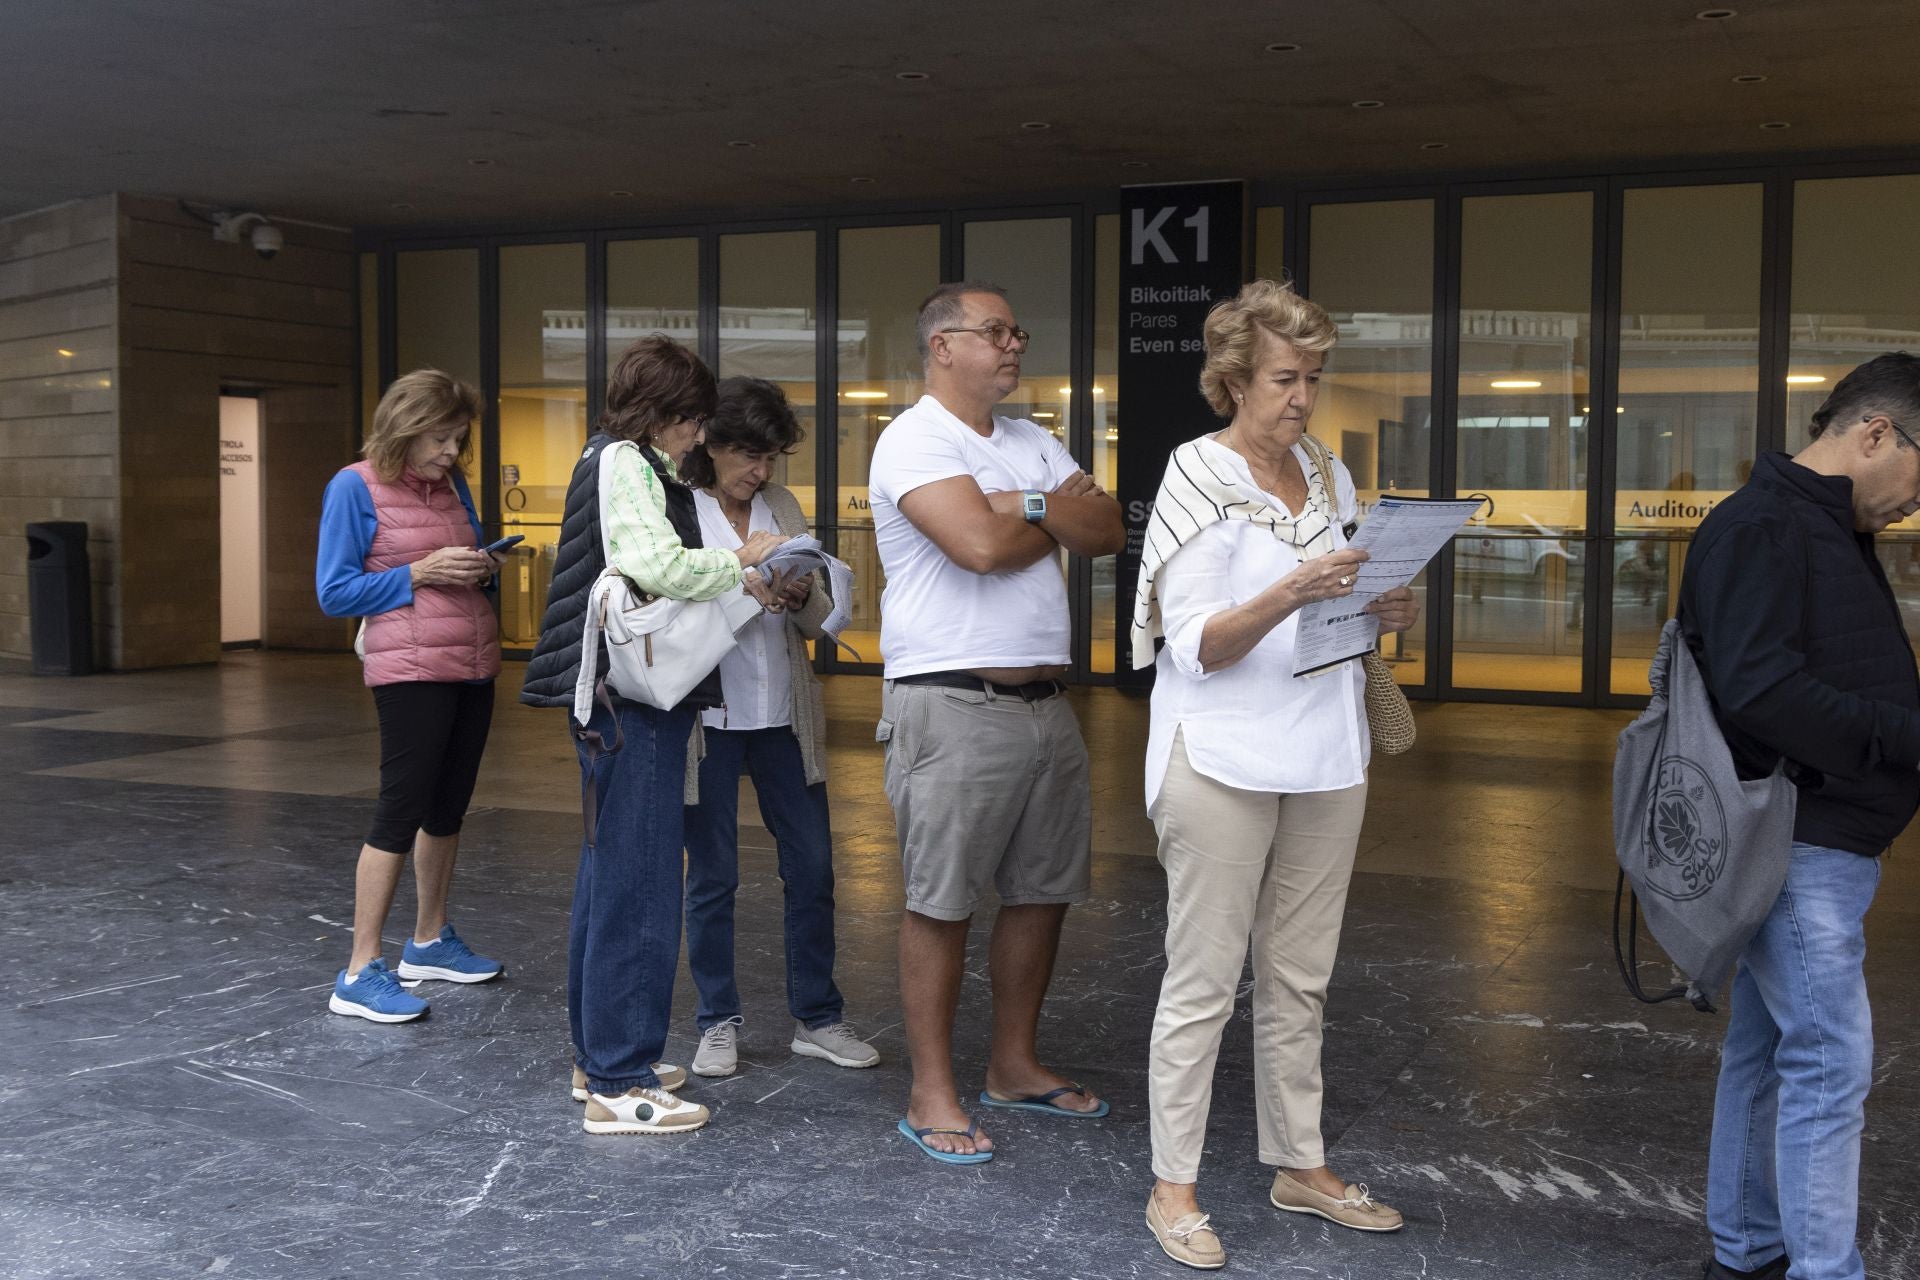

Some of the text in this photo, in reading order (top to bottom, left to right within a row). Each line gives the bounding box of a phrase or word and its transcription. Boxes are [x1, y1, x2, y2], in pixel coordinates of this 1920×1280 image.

[1131, 206, 1210, 265] K1
[1130, 286, 1211, 304] Bikoitiak
[1130, 312, 1177, 328] Pares
[1130, 337, 1174, 353] Even
[219, 440, 244, 449] TROLA
[847, 496, 872, 510] Au
